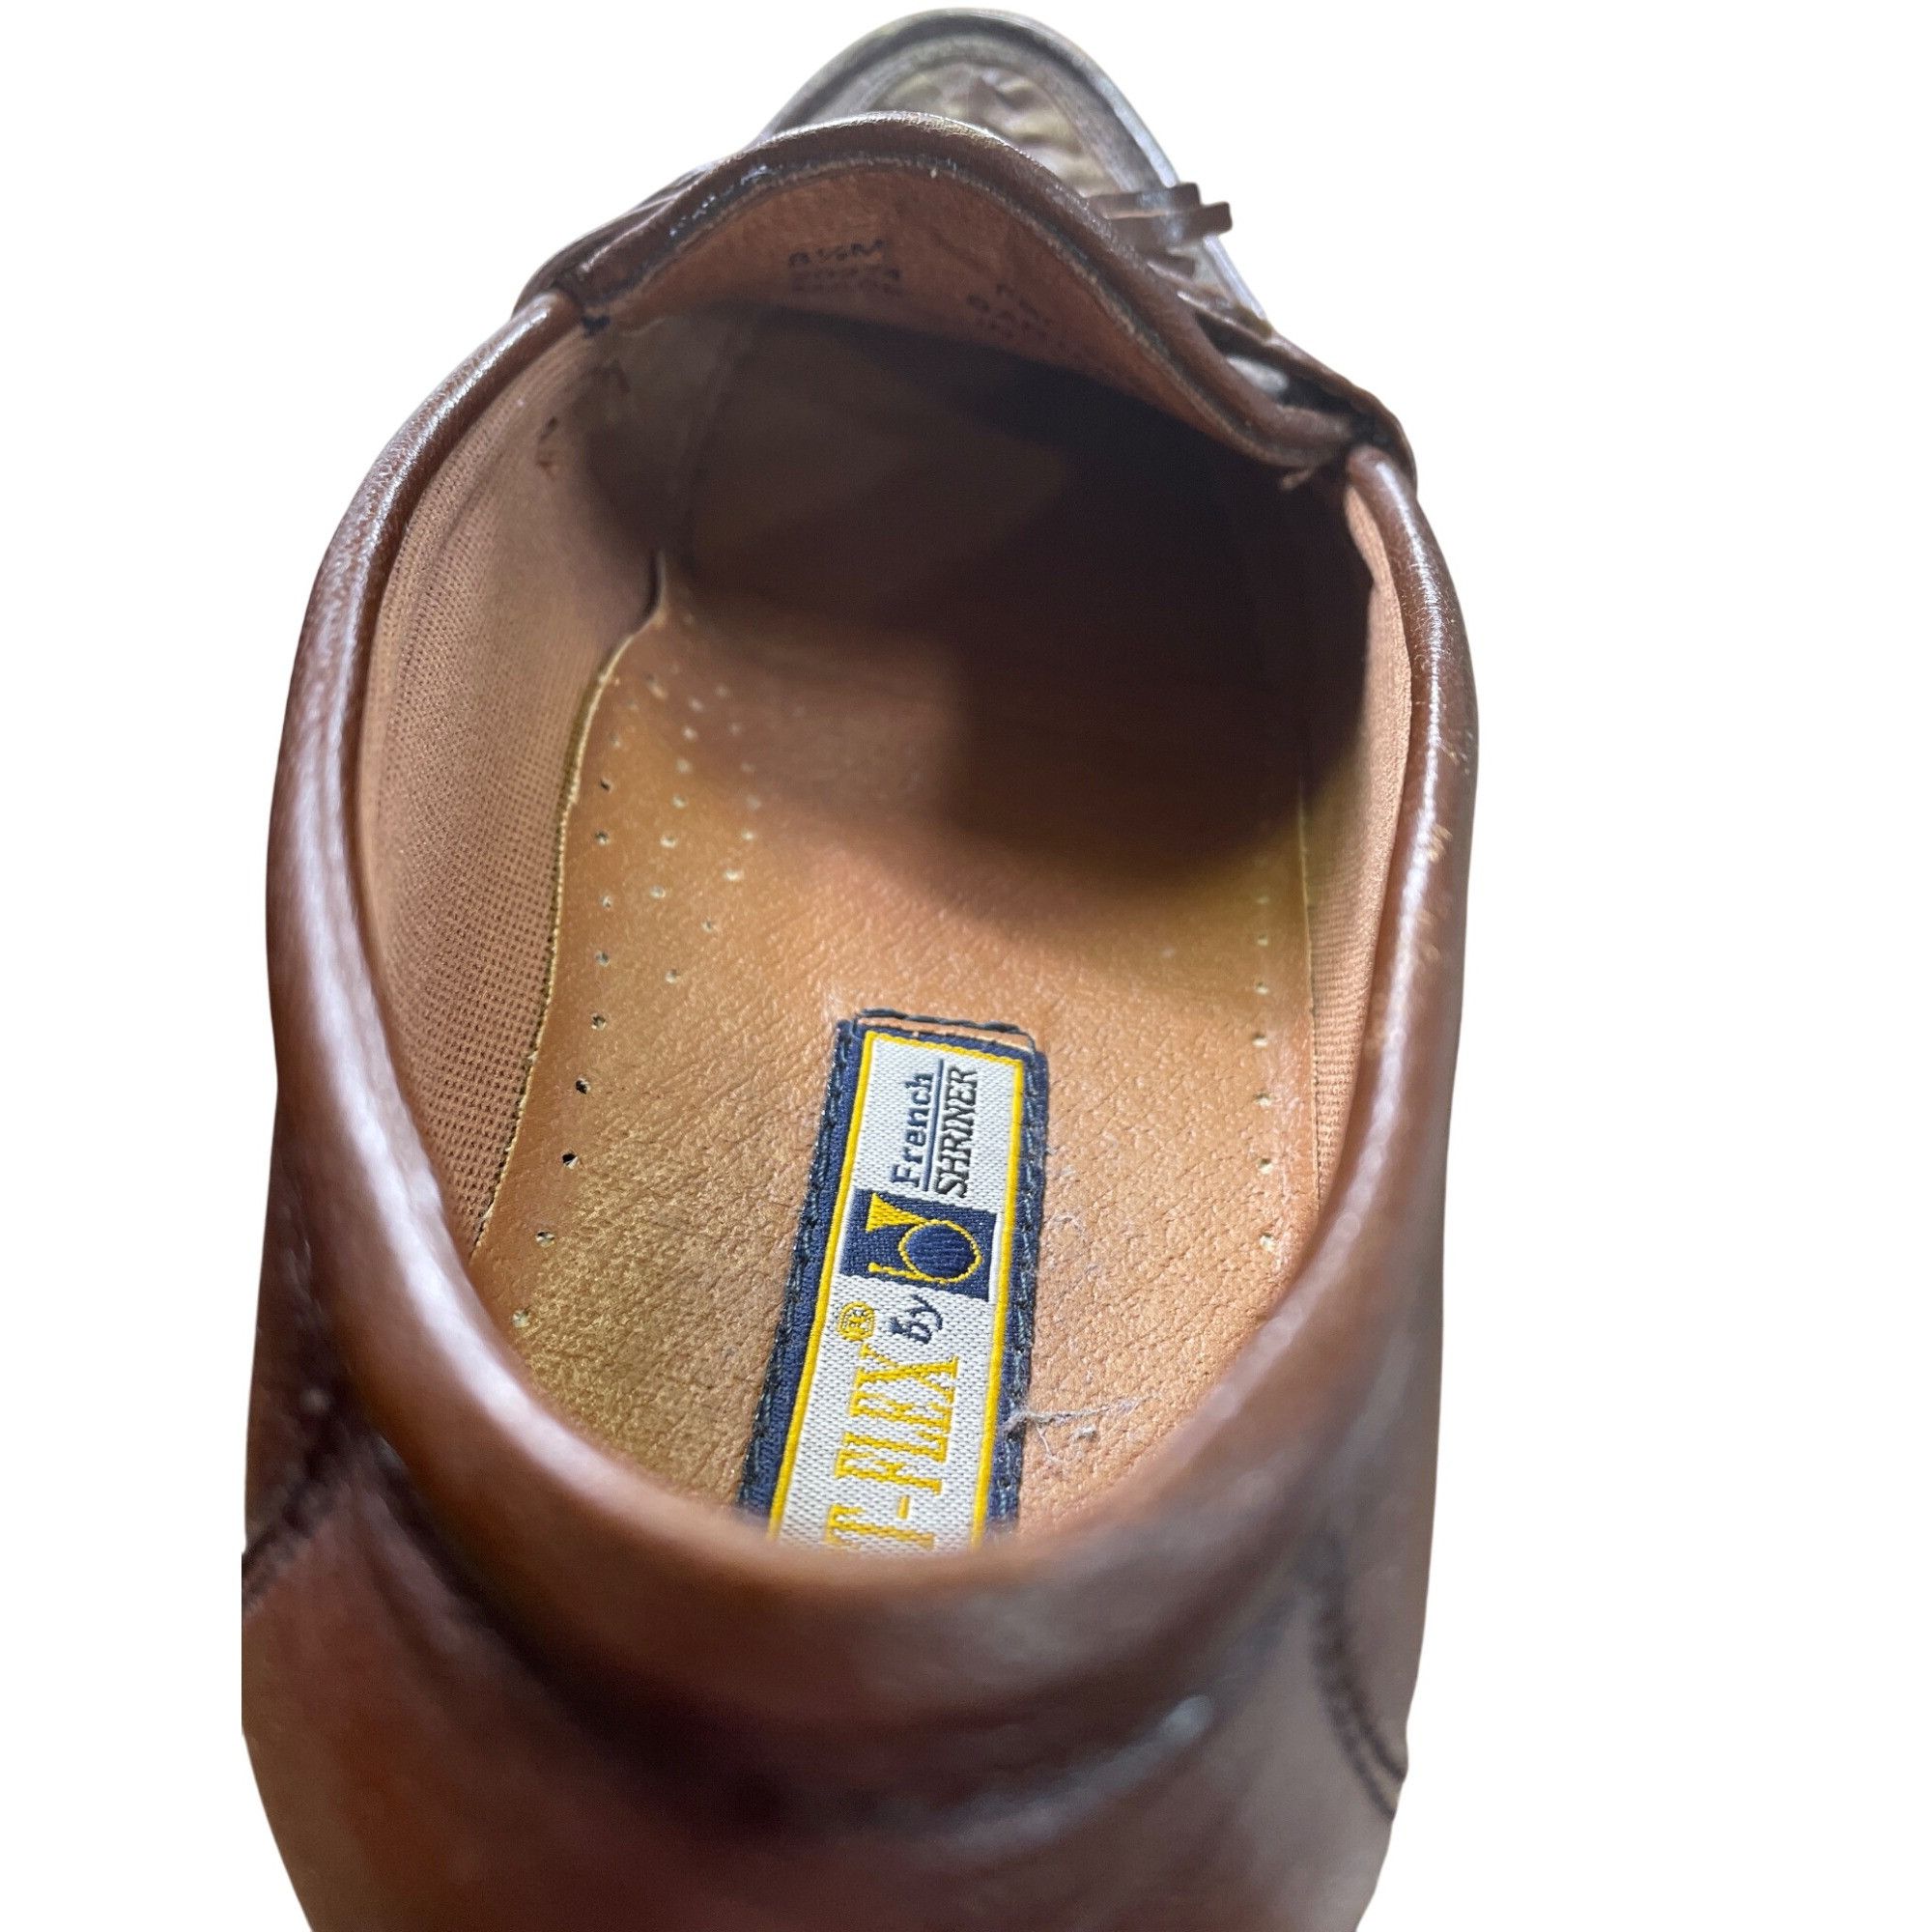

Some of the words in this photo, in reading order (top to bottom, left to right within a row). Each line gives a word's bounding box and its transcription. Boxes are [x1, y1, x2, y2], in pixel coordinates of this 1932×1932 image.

[890, 1071, 935, 1187] French
[933, 1065, 978, 1199] SHRINER
[889, 1293, 943, 1345] by
